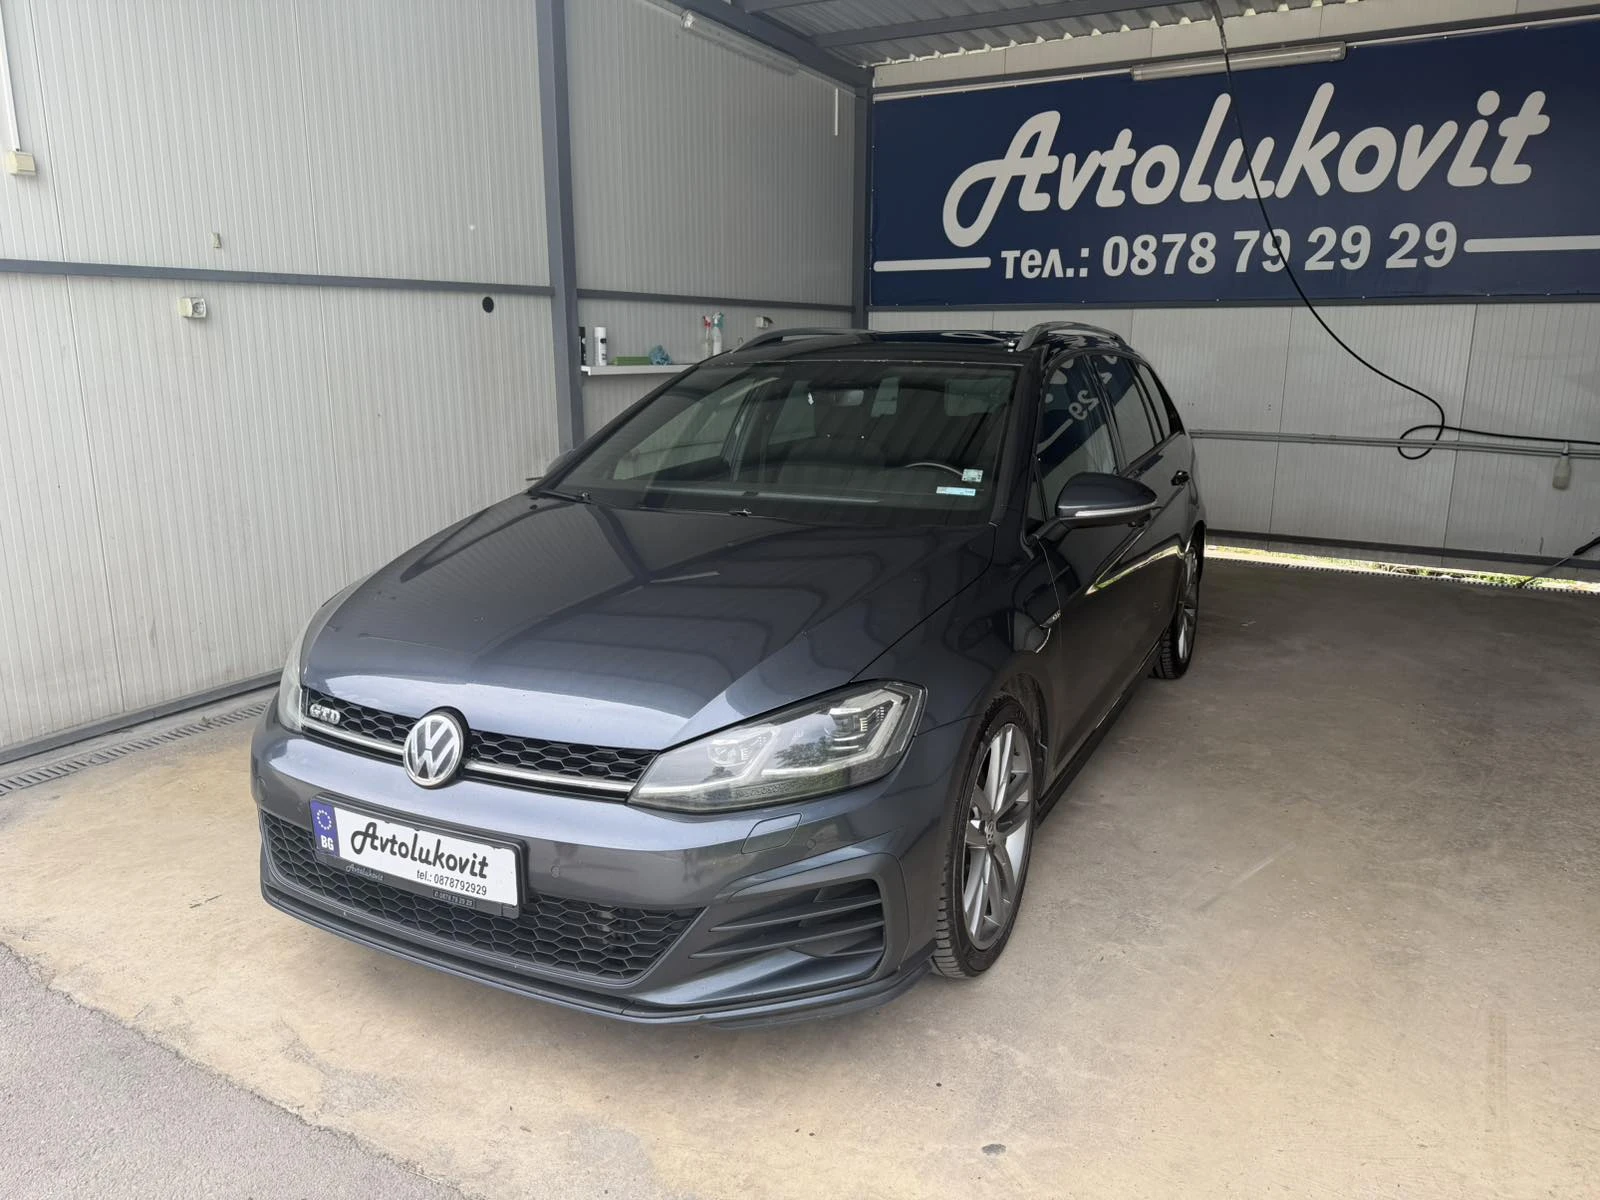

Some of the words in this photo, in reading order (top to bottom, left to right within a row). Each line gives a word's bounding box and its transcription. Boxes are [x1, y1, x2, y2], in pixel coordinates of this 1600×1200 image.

[943, 82, 1551, 247] Avtolukovit
[1103, 231, 1217, 277] 0878
[1233, 228, 1291, 273] 79
[1304, 225, 1372, 271] 29
[1385, 221, 1458, 268] 29
[320, 834, 335, 851] BG
[350, 821, 489, 880] Avtolukovit
[433, 873, 488, 896] 0878792929
